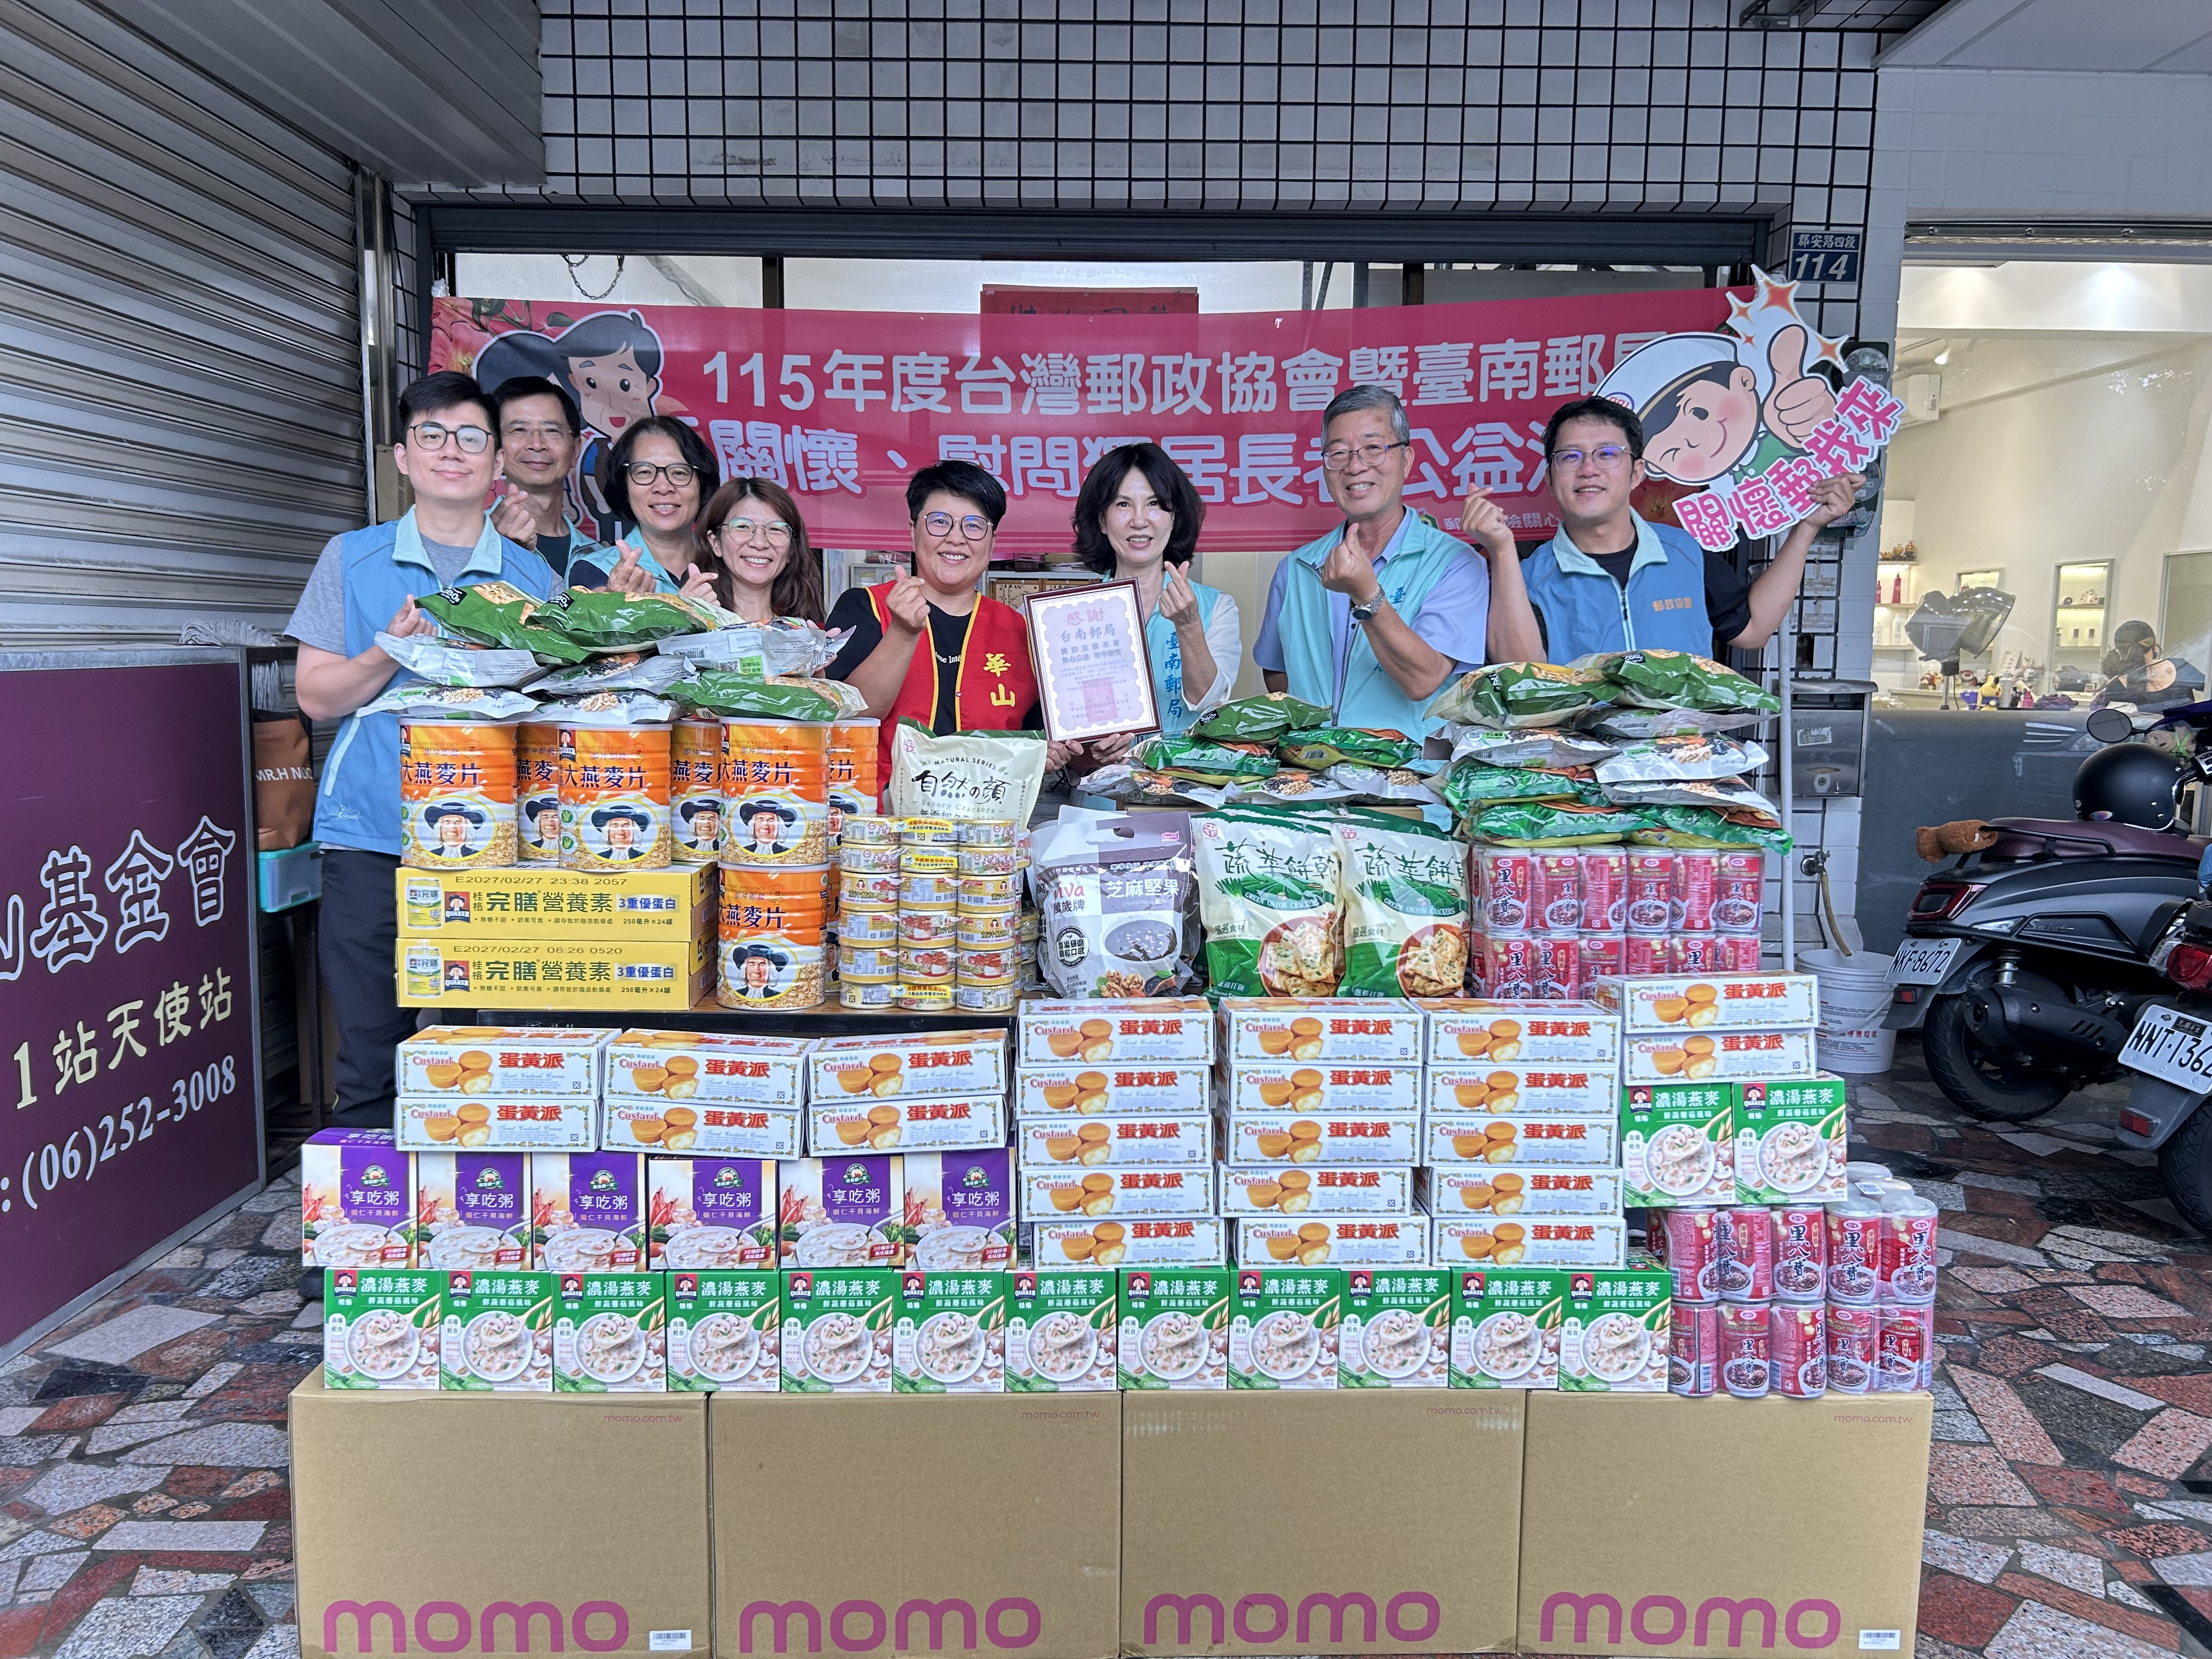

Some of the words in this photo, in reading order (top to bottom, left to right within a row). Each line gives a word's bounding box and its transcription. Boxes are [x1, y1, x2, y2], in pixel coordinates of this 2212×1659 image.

[1797, 234, 1856, 249] 郡安路四段
[1796, 253, 1848, 280] 114
[1066, 608, 1104, 626] 感謝
[1061, 623, 1115, 643] 台南郵局
[983, 652, 1015, 708] 華山
[934, 757, 970, 765] NATURAL
[972, 757, 997, 770] SERIES
[563, 764, 647, 789] 大燕麥片
[921, 799, 952, 810] Savory
[956, 804, 995, 814] Crackers
[455, 876, 543, 884] E2027/02/27
[1105, 877, 1180, 899] 芝麻堅果
[473, 891, 483, 912] 桂格
[618, 896, 676, 910] 3重優蛋白
[1053, 899, 1085, 915] 萬歲牌
[1245, 891, 1265, 905] GREEN
[1267, 900, 1287, 910] ONION
[1290, 899, 1319, 910] CRACKERS
[1406, 906, 1426, 915] ONION
[1430, 907, 1455, 916] CRACKERS
[472, 960, 483, 980] 桂格
[617, 966, 675, 979] 3重優蛋白
[1639, 990, 1679, 1001] Custard
[1725, 982, 1786, 1000] 蛋黃派
[1034, 1025, 1075, 1036] Custard
[1119, 1019, 1182, 1035] 蛋黃派
[1330, 1018, 1392, 1035] 蛋黃派
[1529, 1020, 1590, 1037] 蛋黃派
[1723, 1034, 1783, 1051] 蛋黃派
[412, 1055, 454, 1066] Custard
[499, 1052, 563, 1069] 蛋黃派
[705, 1058, 770, 1077] 蛋黃派
[822, 1061, 864, 1073] Custard
[909, 1049, 972, 1069] 蛋黃派
[1115, 1071, 1177, 1087] 蛋黃派
[1330, 1069, 1392, 1086] 蛋黃派
[1526, 1072, 1588, 1088] 蛋黃派
[1769, 1088, 1835, 1107] 濃湯燕麥
[410, 1108, 452, 1120] Custard
[496, 1104, 561, 1121] 蛋黃派
[704, 1110, 768, 1128] 蛋黃派
[907, 1103, 970, 1121] 蛋黃派
[1118, 1122, 1179, 1139] 蛋黃派
[1328, 1121, 1390, 1138] 蛋黃派
[1524, 1123, 1586, 1139] 蛋黃派
[1121, 1172, 1183, 1189] 蛋黃派
[1318, 1171, 1380, 1187] 蛋黃派
[1531, 1174, 1593, 1190] 蛋黃派
[349, 1190, 400, 1205] 享吃粥
[464, 1193, 514, 1207] 享吃粥
[578, 1195, 628, 1210] 享吃粥
[702, 1192, 752, 1207] 享吃粥
[831, 1189, 881, 1203] 享吃粥
[951, 1192, 1000, 1206] 享吃粥
[1132, 1221, 1194, 1239] 蛋黃派
[1253, 1228, 1293, 1239] Custard
[1338, 1223, 1398, 1239] 蛋黃派
[1532, 1224, 1594, 1241] 蛋黃派
[362, 1276, 428, 1293] 濃湯燕麥
[475, 1279, 540, 1296] 濃湯燕麥
[587, 1280, 651, 1297] 濃湯燕麥
[702, 1280, 766, 1297] 濃湯燕麥
[928, 1279, 992, 1296] 濃湯燕麥
[1154, 1280, 1218, 1296] 濃湯燕麥
[1596, 1281, 1660, 1297] 濃湯燕麥
[603, 1414, 684, 1423] momo.com.tw
[1022, 1410, 1099, 1420] momo.com.tw
[1426, 1407, 1503, 1415] momo.com.tw
[1833, 1414, 1912, 1424] momo.com.tw
[739, 1597, 1041, 1654] momo
[1143, 1591, 1441, 1645] momo
[1540, 1592, 1841, 1649] momo
[324, 1600, 629, 1654] momo
